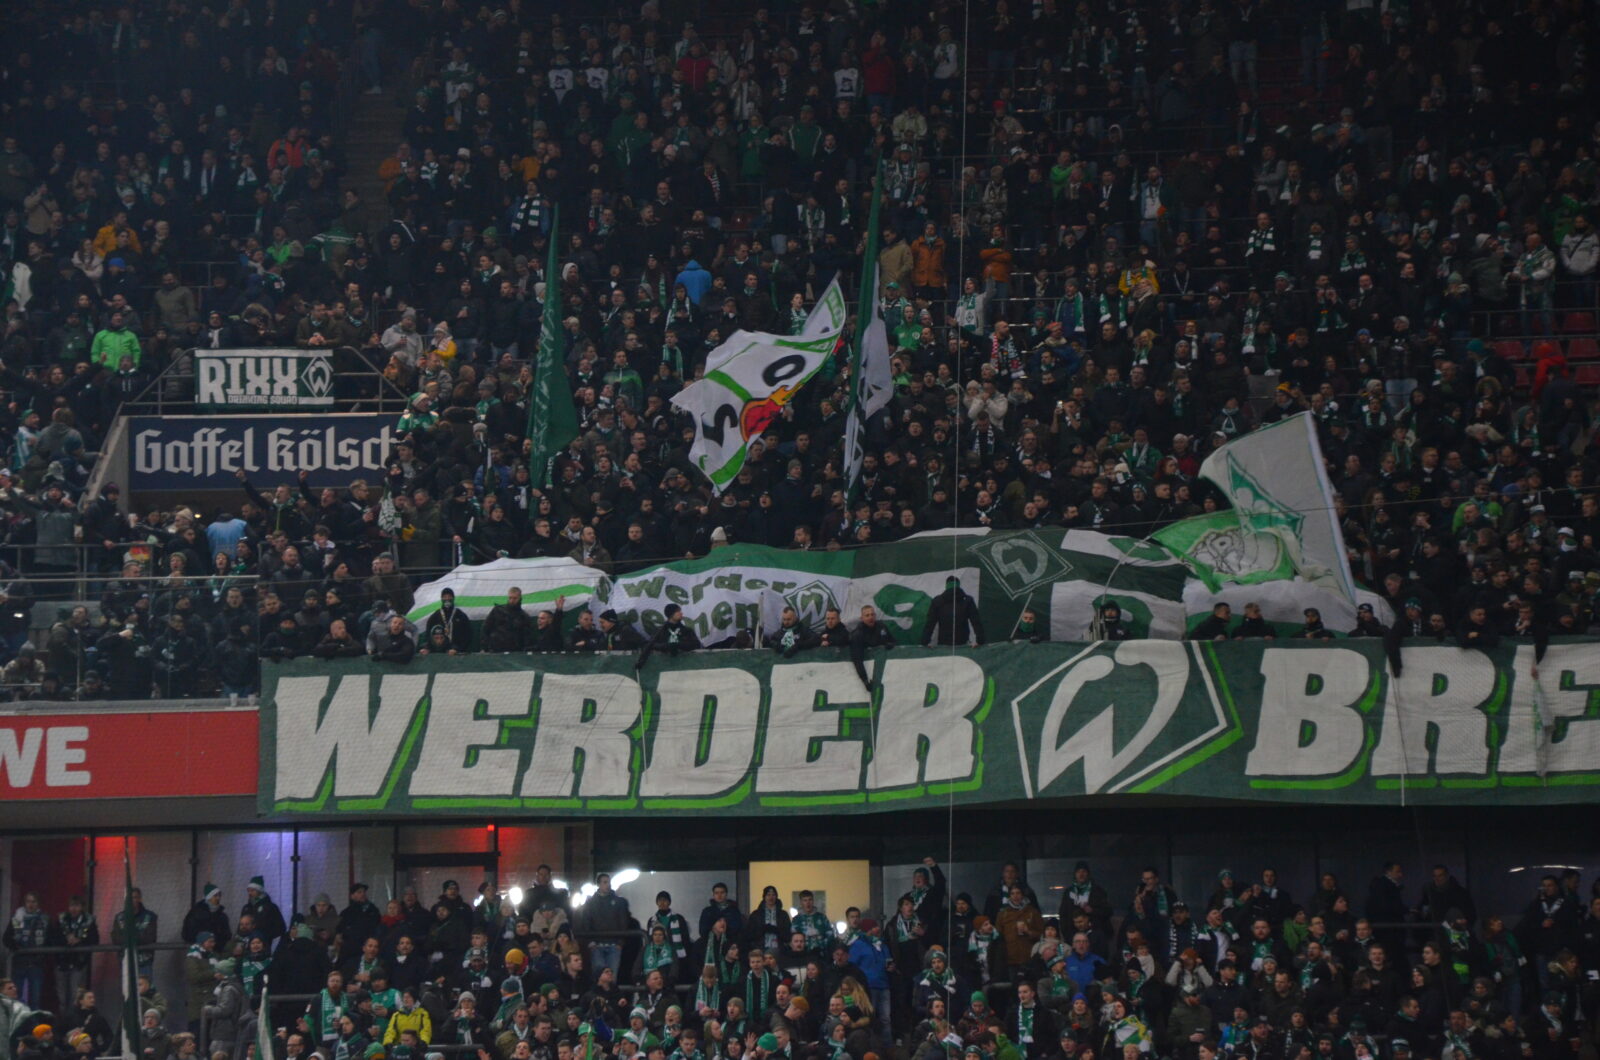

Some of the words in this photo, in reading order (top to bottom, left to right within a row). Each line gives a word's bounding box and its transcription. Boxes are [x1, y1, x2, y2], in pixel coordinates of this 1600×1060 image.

[200, 358, 298, 403] RIXX
[135, 427, 260, 477] Gaffel
[622, 574, 797, 605] Werder
[615, 602, 760, 640] remen
[274, 656, 986, 801] WERDER
